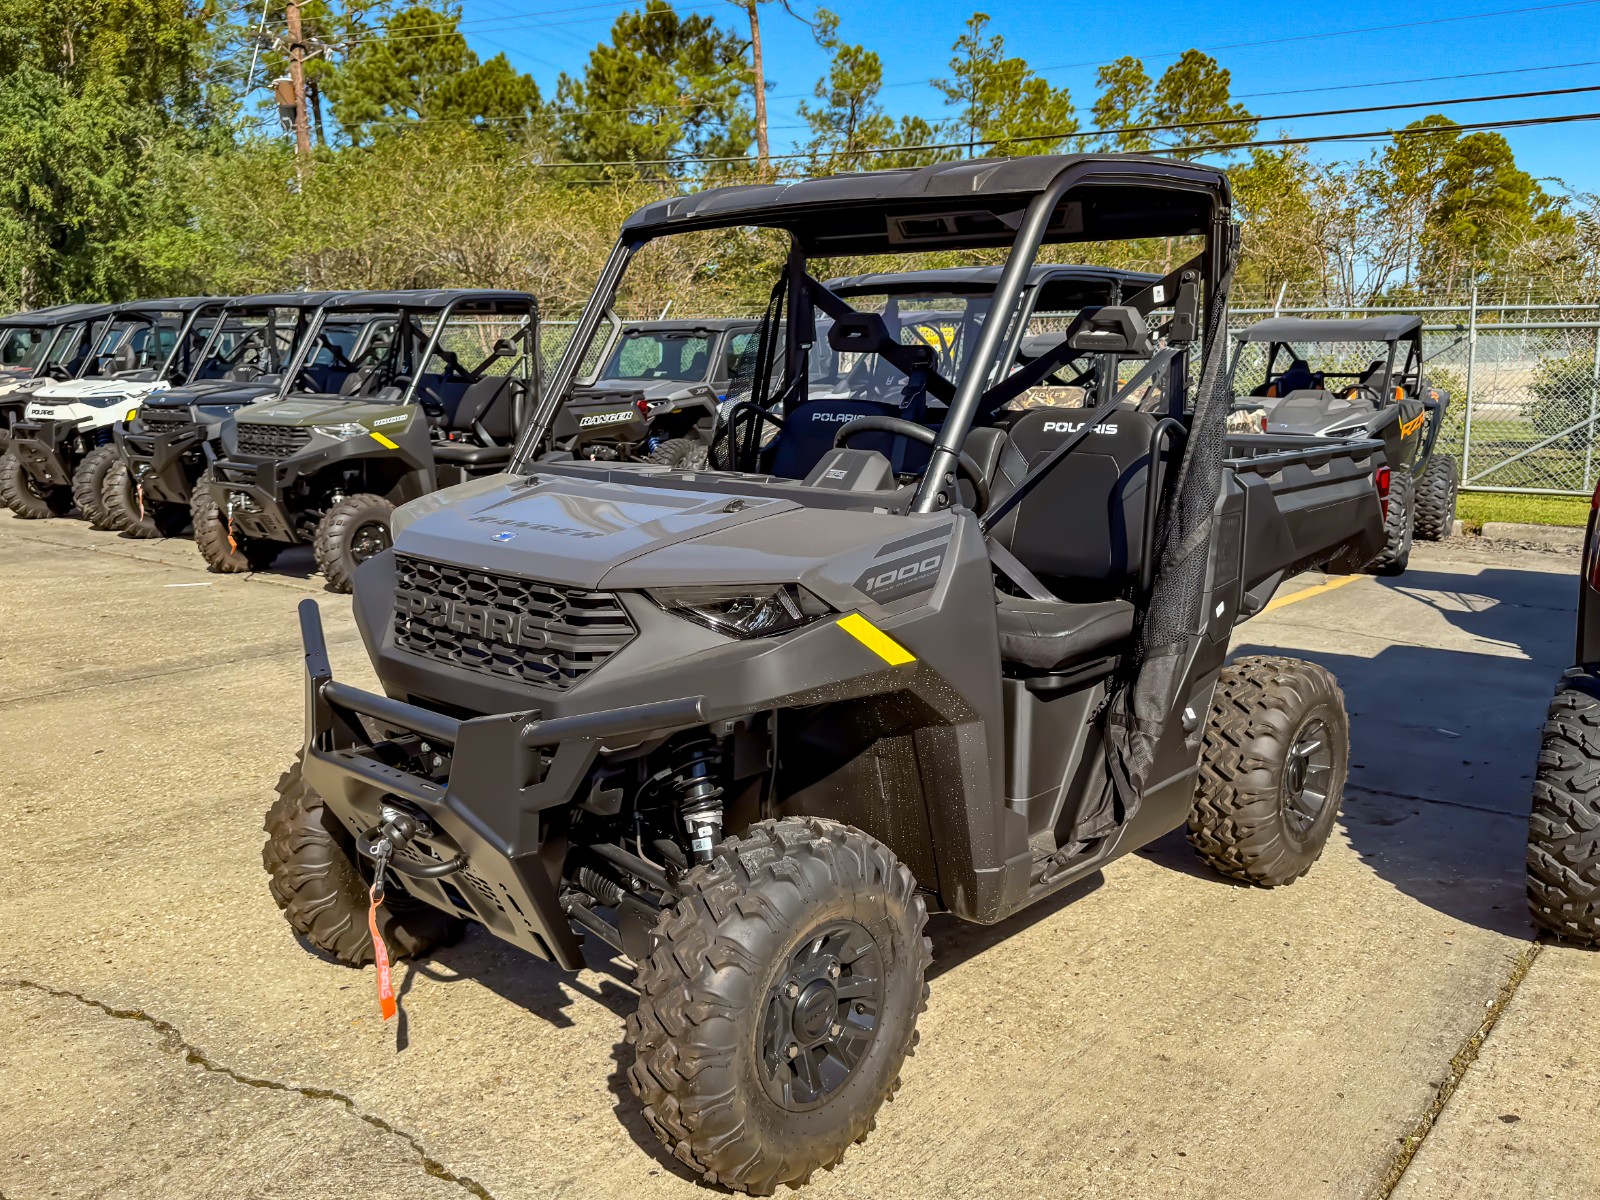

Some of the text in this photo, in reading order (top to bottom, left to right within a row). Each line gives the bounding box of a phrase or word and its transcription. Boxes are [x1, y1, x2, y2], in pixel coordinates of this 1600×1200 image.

[579, 411, 634, 427] RANGER
[467, 516, 605, 539] RANGER
[865, 554, 941, 592] 1000
[408, 591, 551, 650] POLARIS
